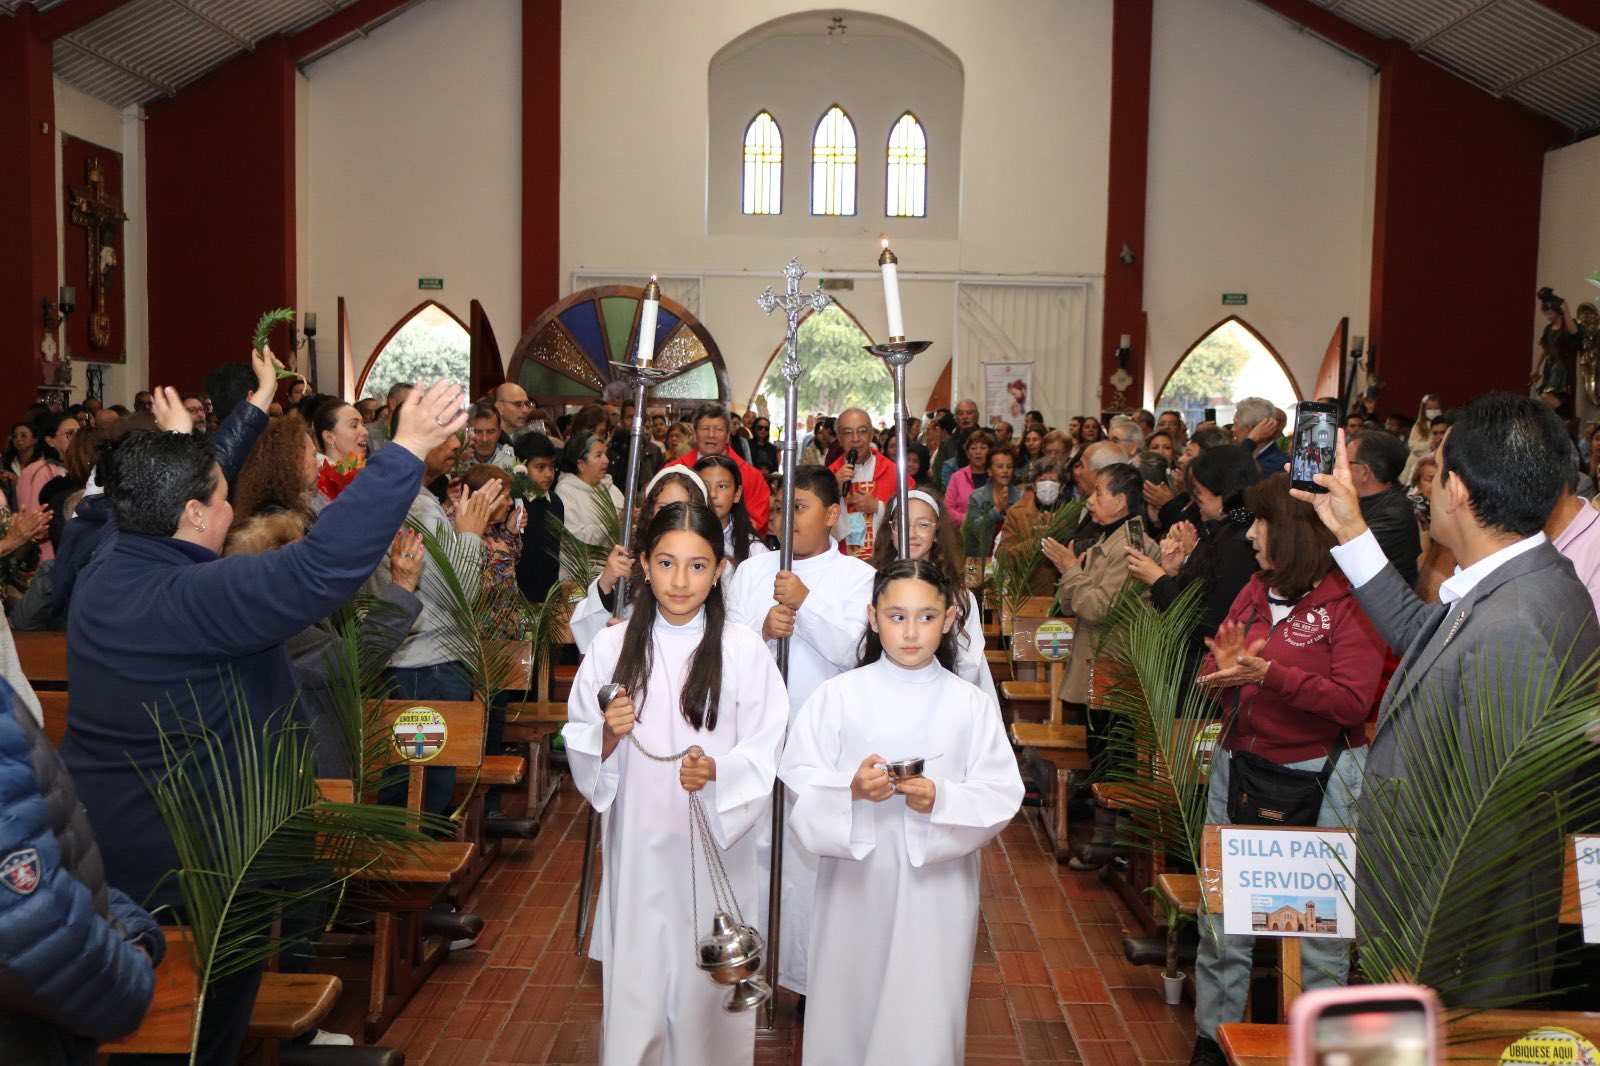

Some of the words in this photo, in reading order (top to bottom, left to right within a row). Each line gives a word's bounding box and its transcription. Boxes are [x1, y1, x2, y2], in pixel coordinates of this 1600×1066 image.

[1228, 838, 1284, 858] SILLA
[1290, 840, 1349, 860] PARA
[1239, 870, 1347, 891] SERVIDOR
[1509, 1045, 1550, 1058] UBIQUESE
[1553, 1046, 1573, 1059] AQUI
